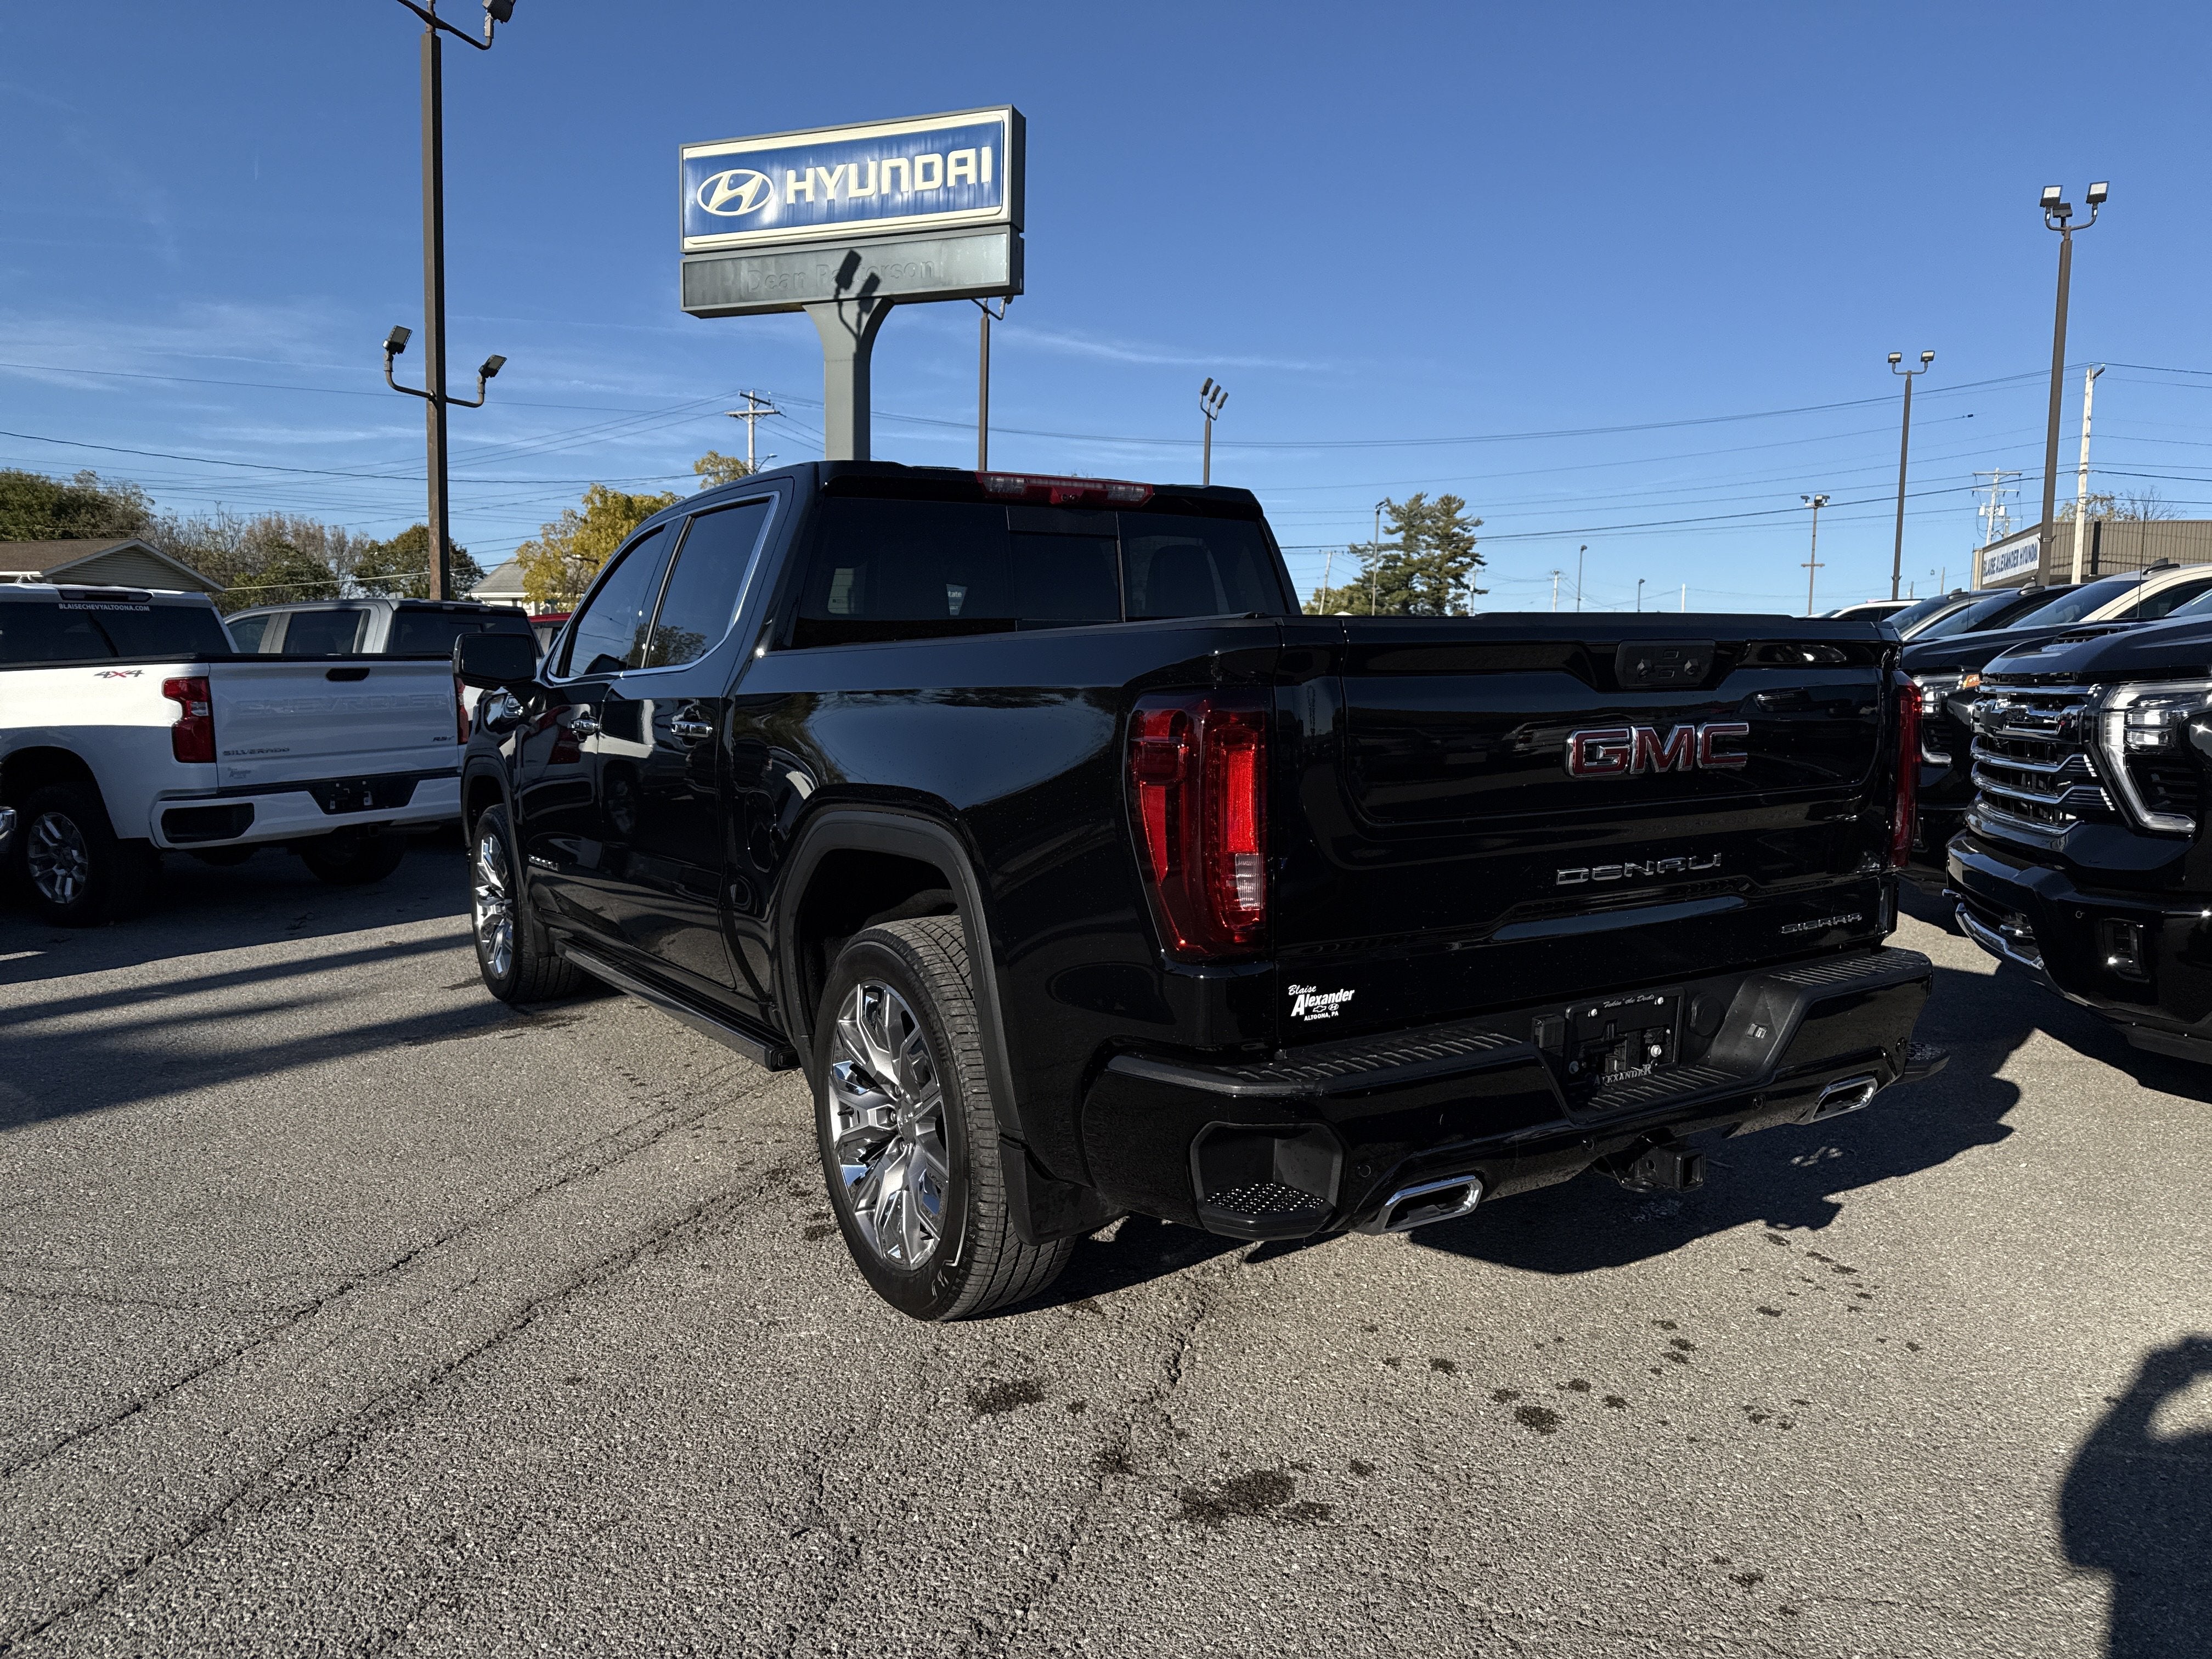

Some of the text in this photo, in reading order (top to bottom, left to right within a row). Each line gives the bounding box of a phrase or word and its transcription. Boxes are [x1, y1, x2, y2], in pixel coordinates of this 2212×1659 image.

[786, 145, 992, 205] HYUNDAI
[746, 259, 935, 293] Dean Paterson
[59, 603, 150, 612] BLAISECHEVYALTOONA.COM
[223, 746, 290, 756] SILVERADO
[1565, 721, 1750, 778] GMC
[1556, 852, 1722, 885] DENALI
[1781, 912, 1863, 934] SIERRA
[1288, 984, 1317, 996] Blaise
[1290, 989, 1355, 1017] Alexander
[1304, 1012, 1331, 1021] ALTOONA,
[1593, 1063, 1652, 1087] ALEXANDER
